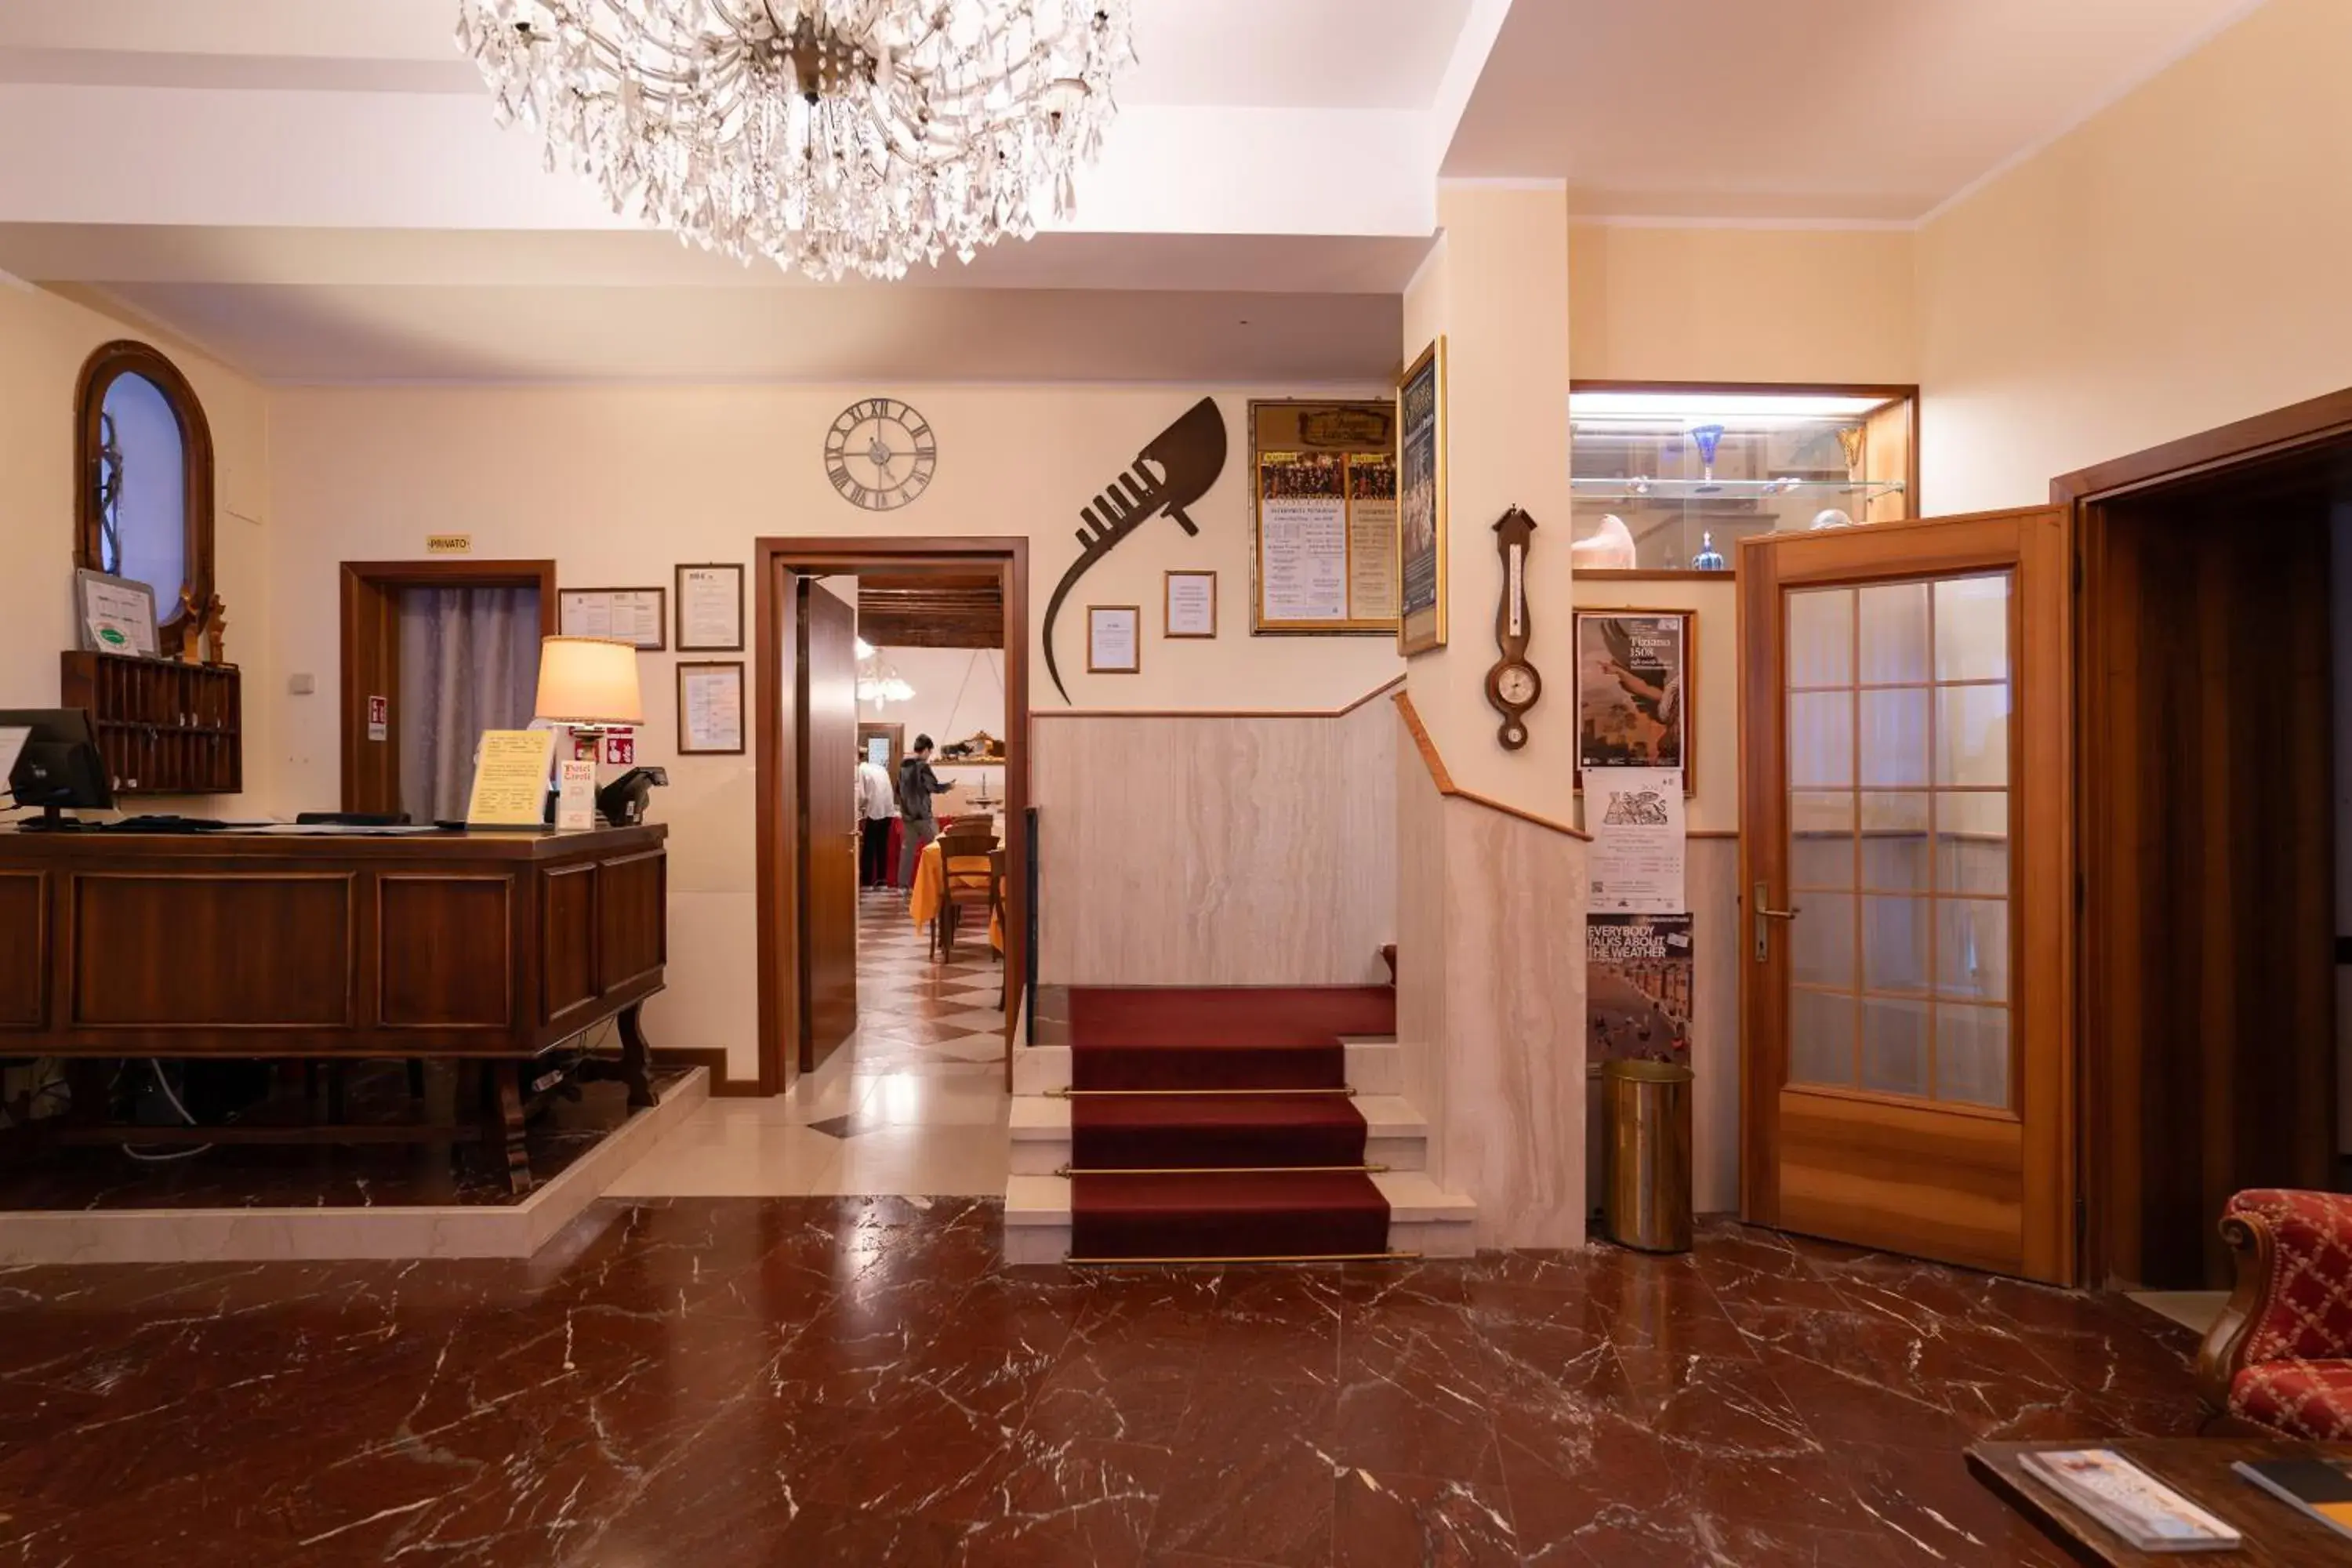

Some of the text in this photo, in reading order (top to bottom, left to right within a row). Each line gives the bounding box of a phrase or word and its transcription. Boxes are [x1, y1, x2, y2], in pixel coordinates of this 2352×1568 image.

[1630, 636, 1671, 647] Tiziano
[1588, 925, 1654, 937] EVERYBODY
[1589, 935, 1665, 947] TALKS ABOUT
[1588, 946, 1665, 957] THE WEATHER
